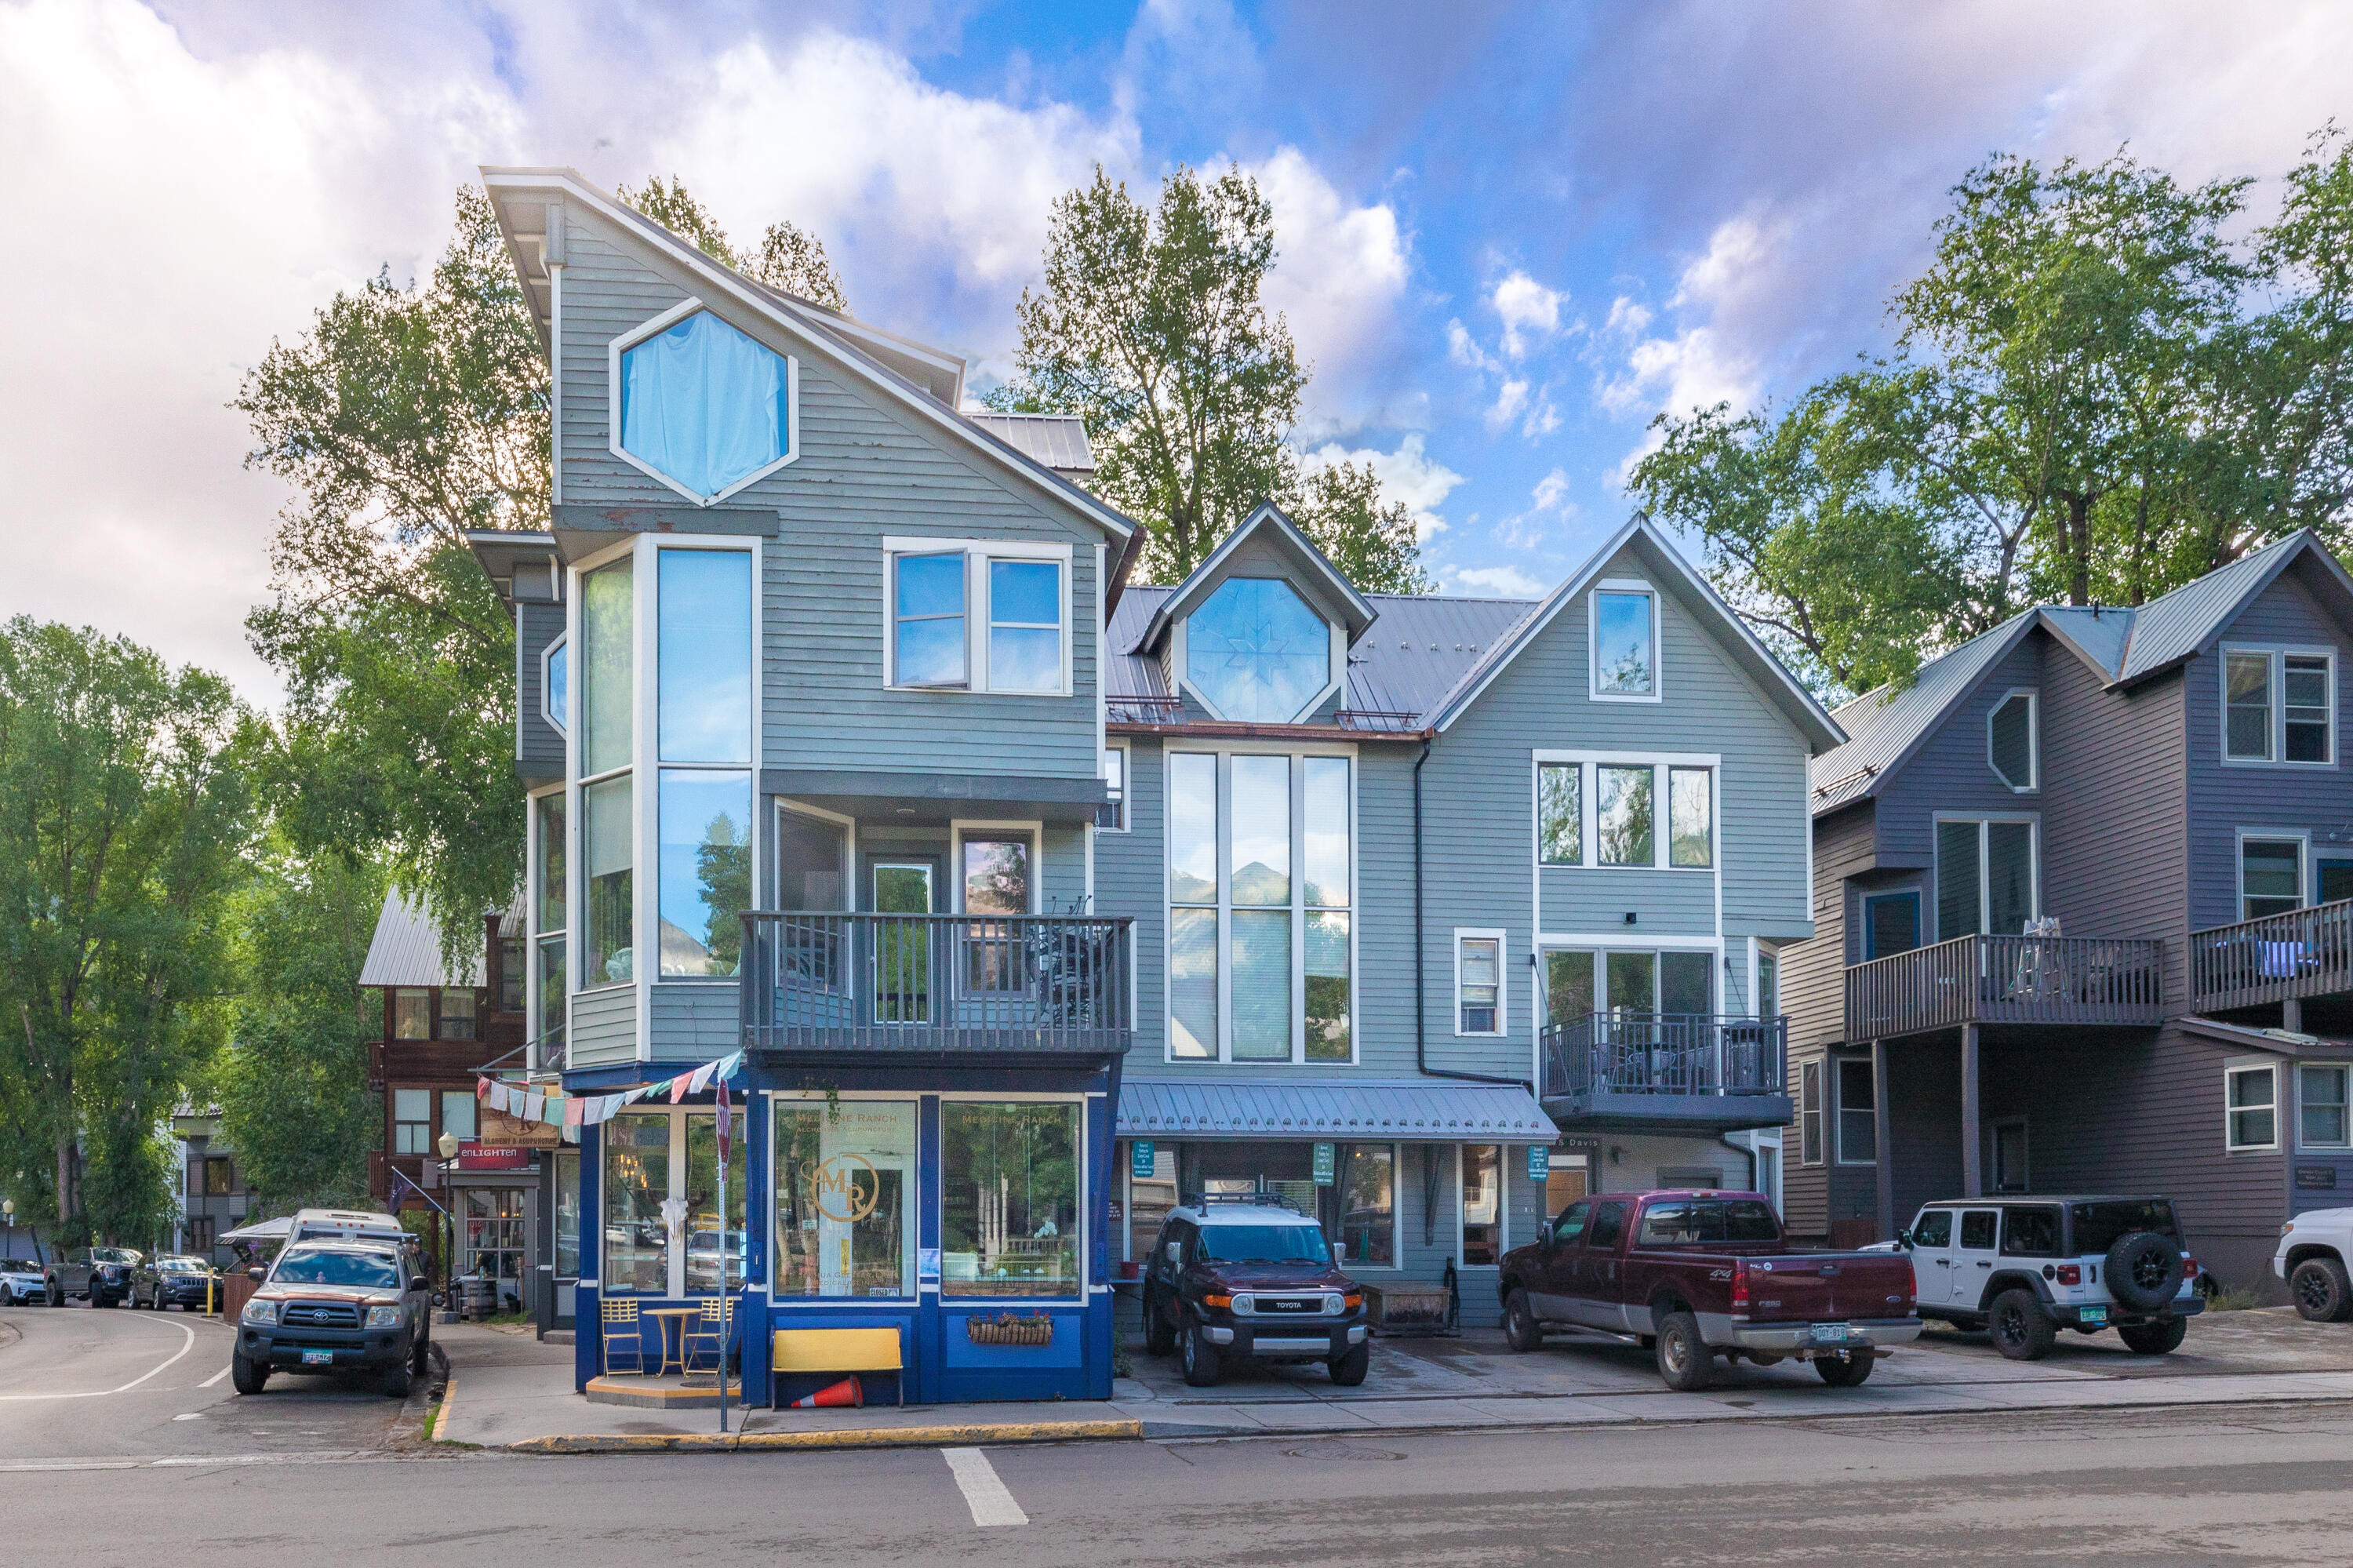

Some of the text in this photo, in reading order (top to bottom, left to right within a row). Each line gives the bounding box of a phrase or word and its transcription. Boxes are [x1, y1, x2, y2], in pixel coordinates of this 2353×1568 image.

[718, 1104, 731, 1138] STOP
[796, 1114, 896, 1122] MEDICNE RANCH
[1022, 1115, 1060, 1123] RANCH
